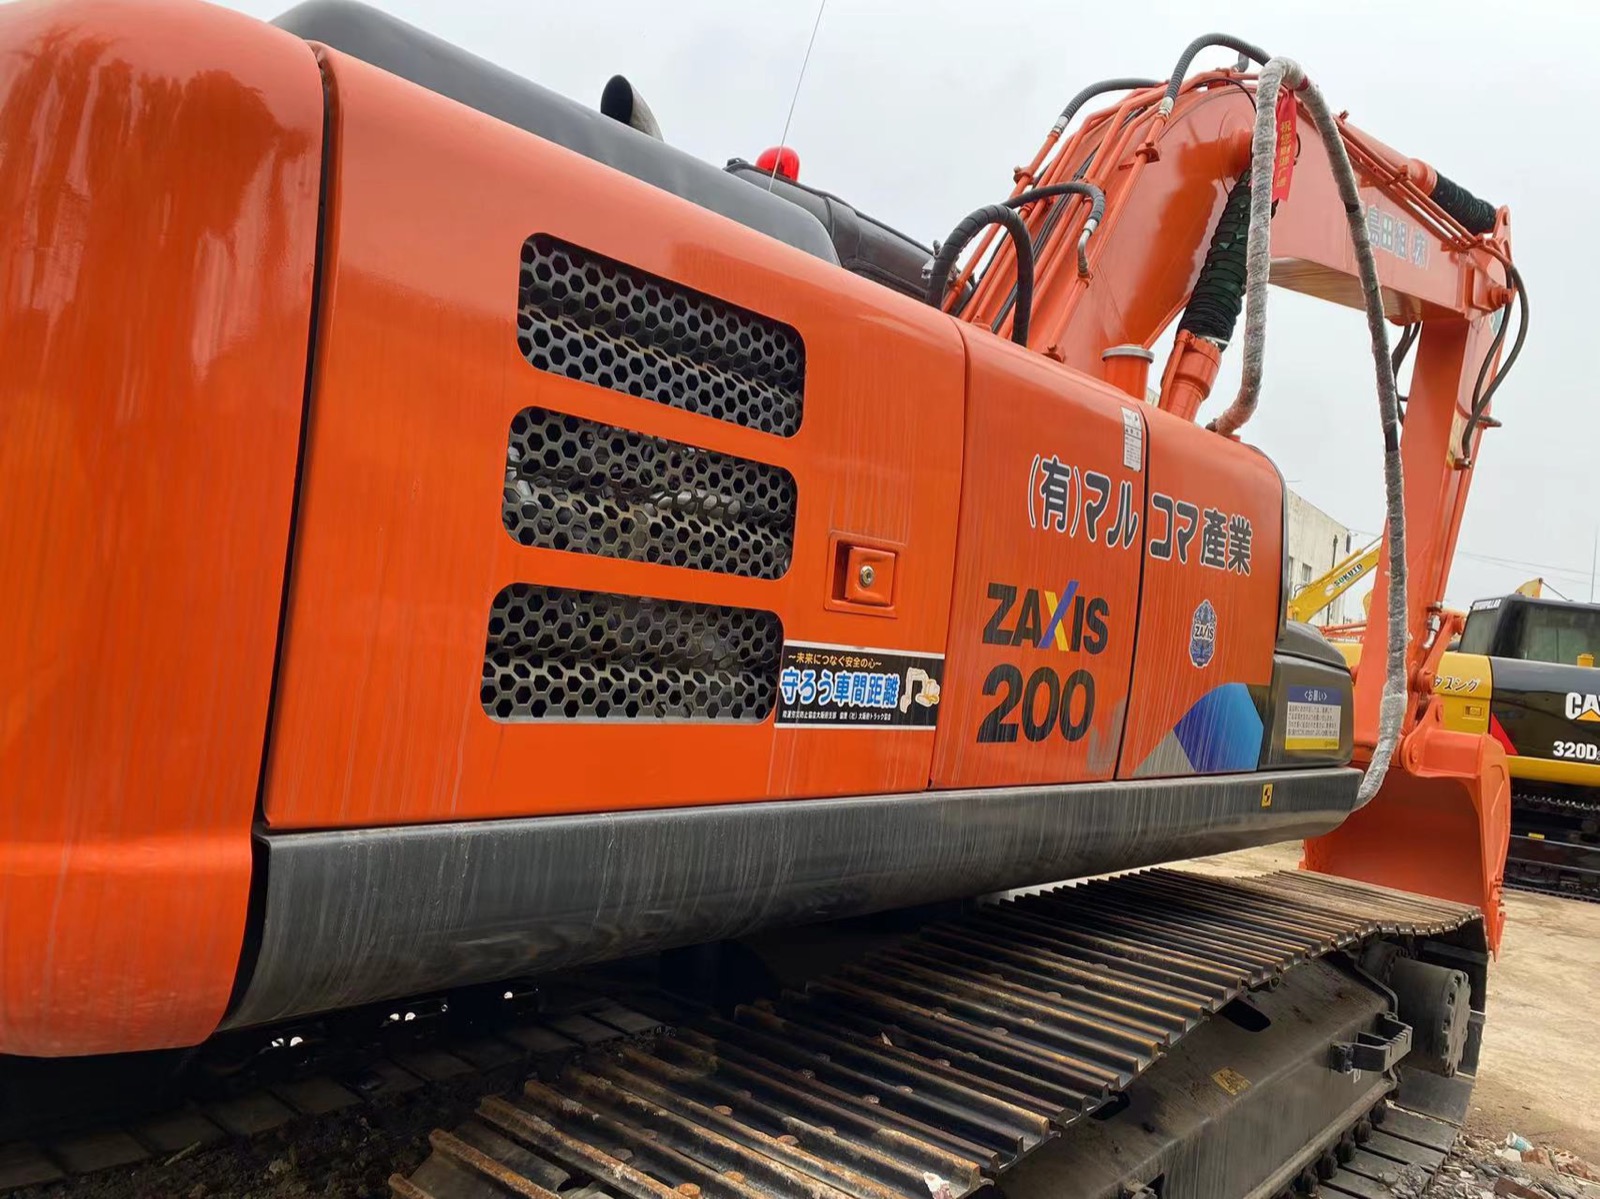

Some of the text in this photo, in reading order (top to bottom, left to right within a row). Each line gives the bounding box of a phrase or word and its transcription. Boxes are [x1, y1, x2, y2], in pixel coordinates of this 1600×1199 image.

[983, 580, 1110, 655] ZAXIS
[779, 667, 901, 708] 守ろう車間距離
[977, 663, 1096, 744] 200
[1565, 692, 1600, 720] CA
